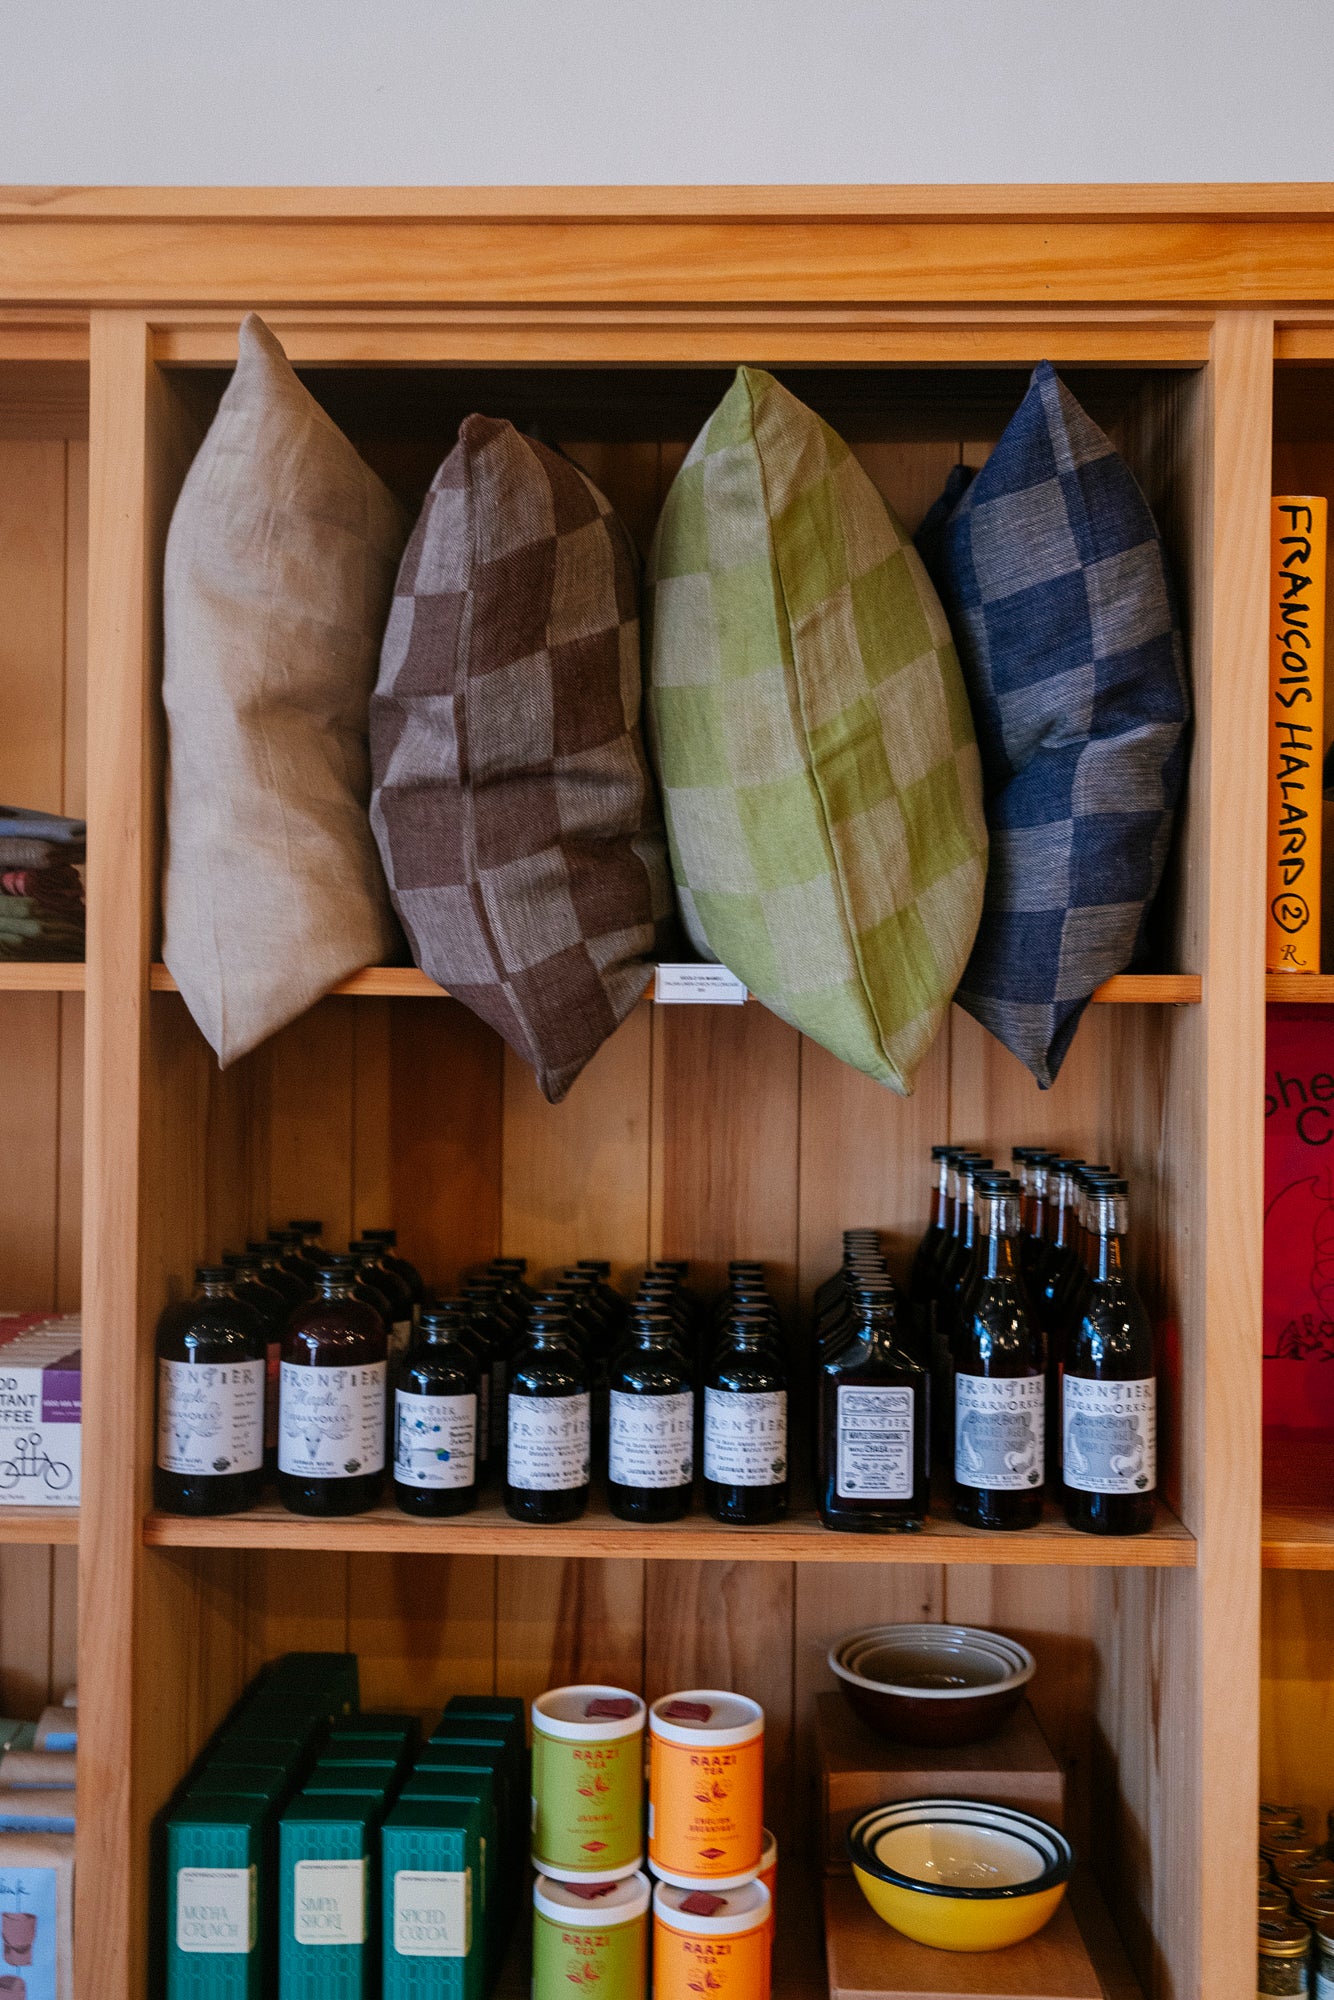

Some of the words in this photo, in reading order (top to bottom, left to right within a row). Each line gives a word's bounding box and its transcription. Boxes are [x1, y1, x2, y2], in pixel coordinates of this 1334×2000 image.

[1275, 504, 1313, 708] FRANÇOIS
[1274, 721, 1313, 886] HALARD
[1280, 944, 1307, 966] R
[572, 1749, 620, 1761] RAAZI
[689, 1754, 737, 1766] RAAZI
[585, 1760, 607, 1769] TEA
[703, 1766, 724, 1775] TEA
[561, 1932, 610, 1947] RAAZI
[575, 1946, 597, 1956] TEA
[682, 1941, 732, 1955] RAAZI
[695, 1954, 718, 1965] TEA
